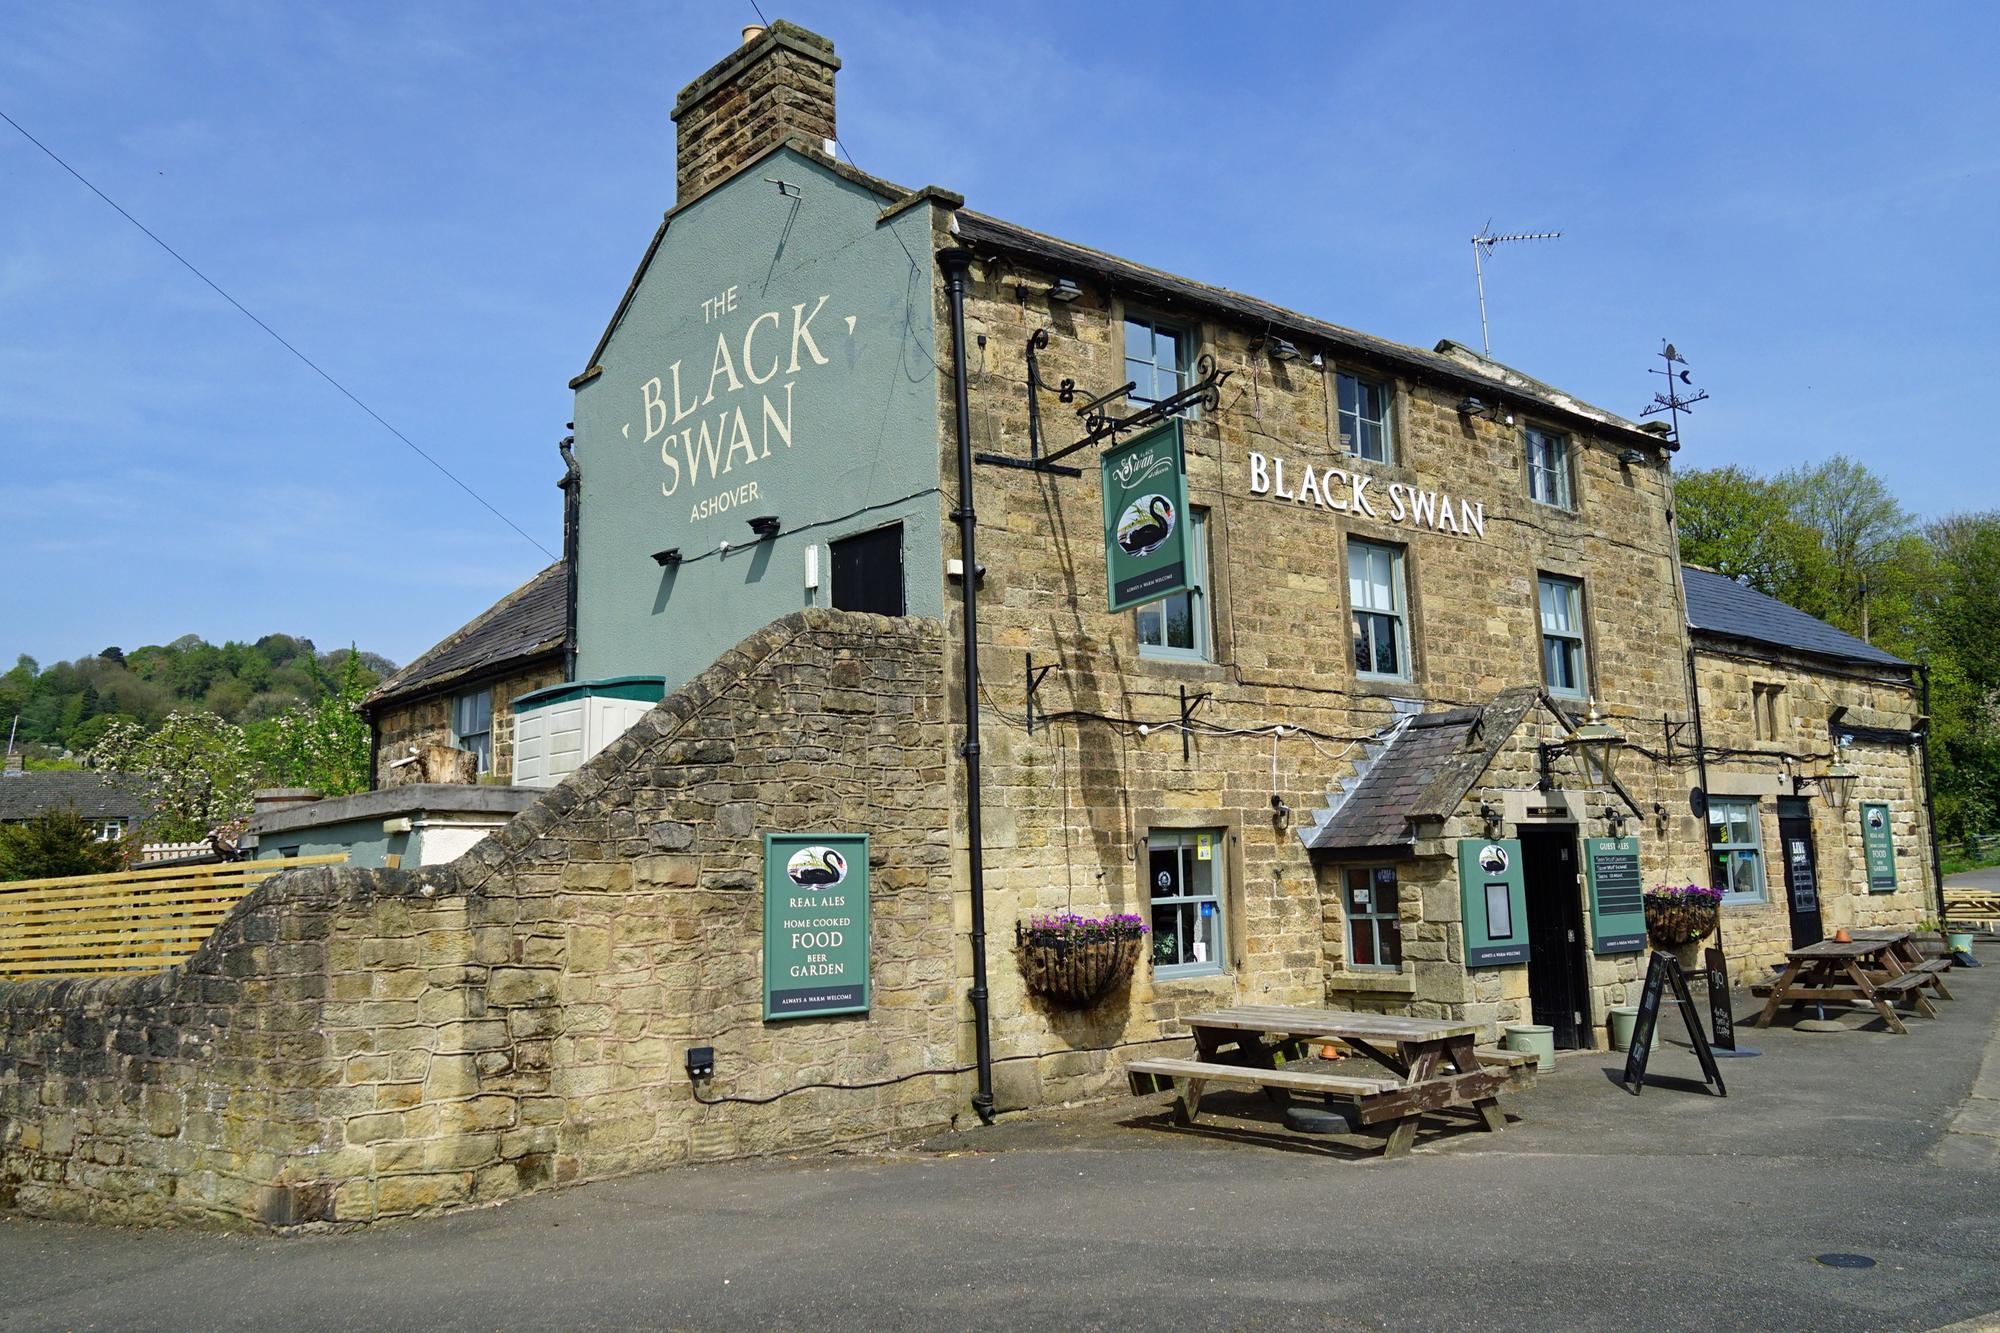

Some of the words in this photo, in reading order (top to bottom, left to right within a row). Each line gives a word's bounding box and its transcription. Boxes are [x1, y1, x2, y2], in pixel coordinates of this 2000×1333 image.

[701, 285, 738, 324] THE
[640, 294, 830, 443] BLACK
[661, 381, 796, 497] SWAN
[689, 481, 759, 523] ASHOVER
[1248, 452, 1376, 517] BLACK
[1388, 483, 1485, 539] SWAN
[1599, 842, 1616, 851] GUEST
[789, 897, 817, 908] REAL
[821, 896, 845, 907] ALES
[783, 919, 811, 929] HOME
[813, 917, 851, 928] COOKED
[791, 932, 843, 949] FOOD
[807, 953, 828, 963] BEER
[790, 963, 844, 978] GARDEN
[826, 993, 852, 1001] WELCOME
